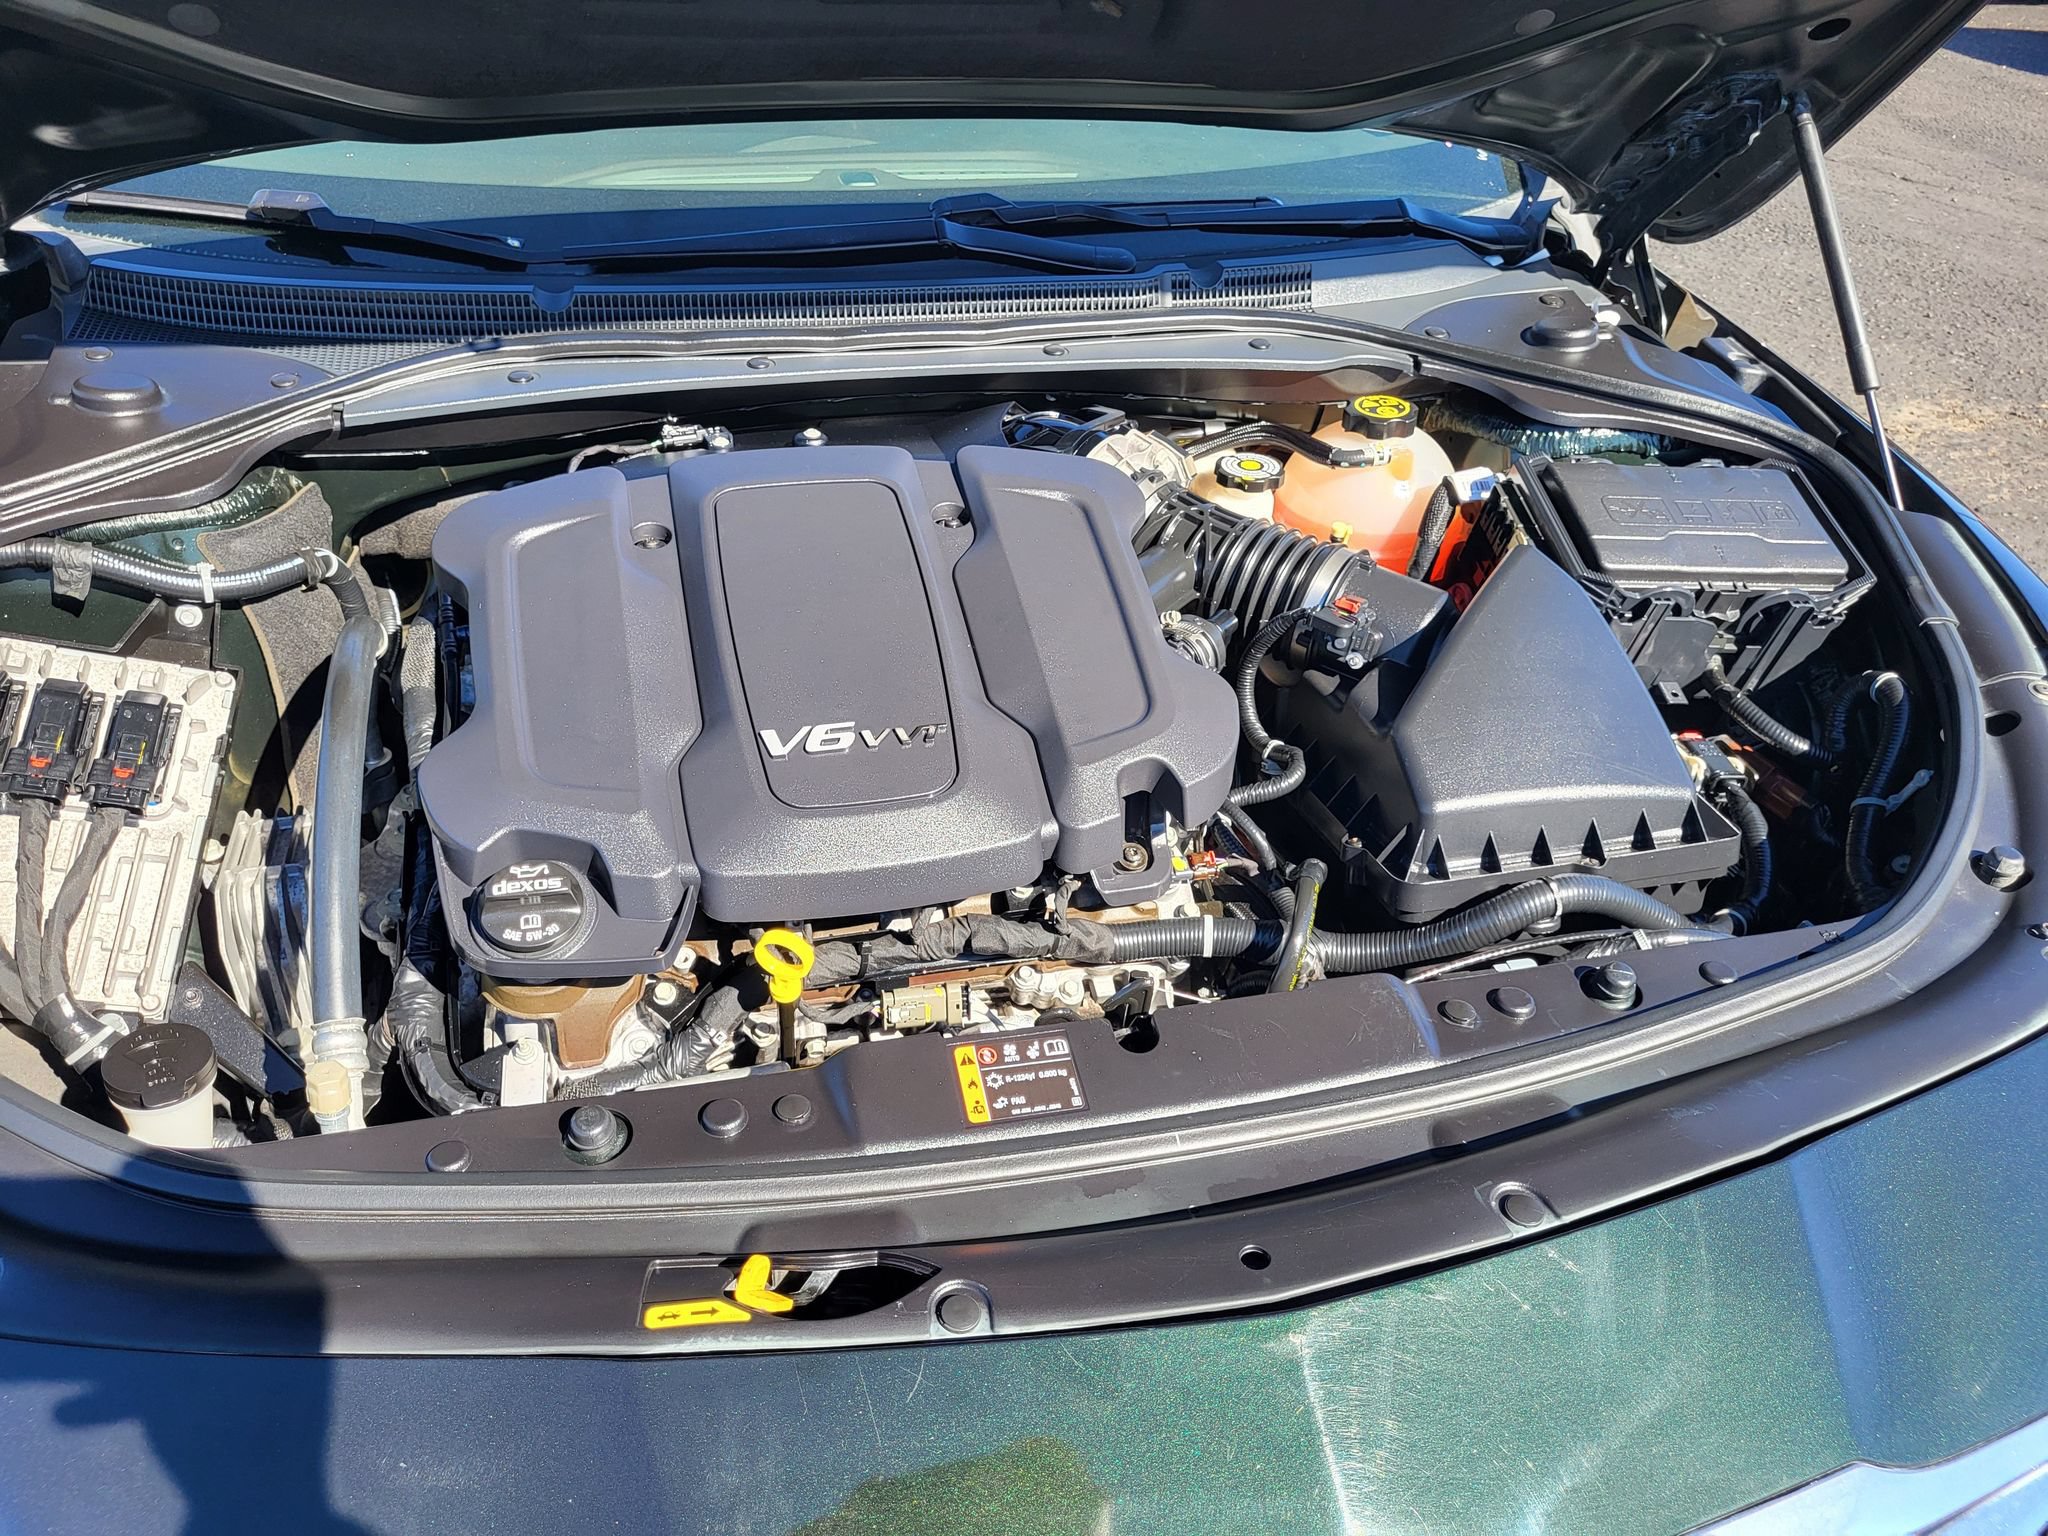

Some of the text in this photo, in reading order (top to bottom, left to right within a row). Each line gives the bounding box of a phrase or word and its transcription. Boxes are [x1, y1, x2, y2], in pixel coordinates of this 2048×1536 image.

[759, 721, 948, 758] V6 VVT
[492, 877, 564, 896] dexos
[502, 923, 560, 942] SAE 5W-30
